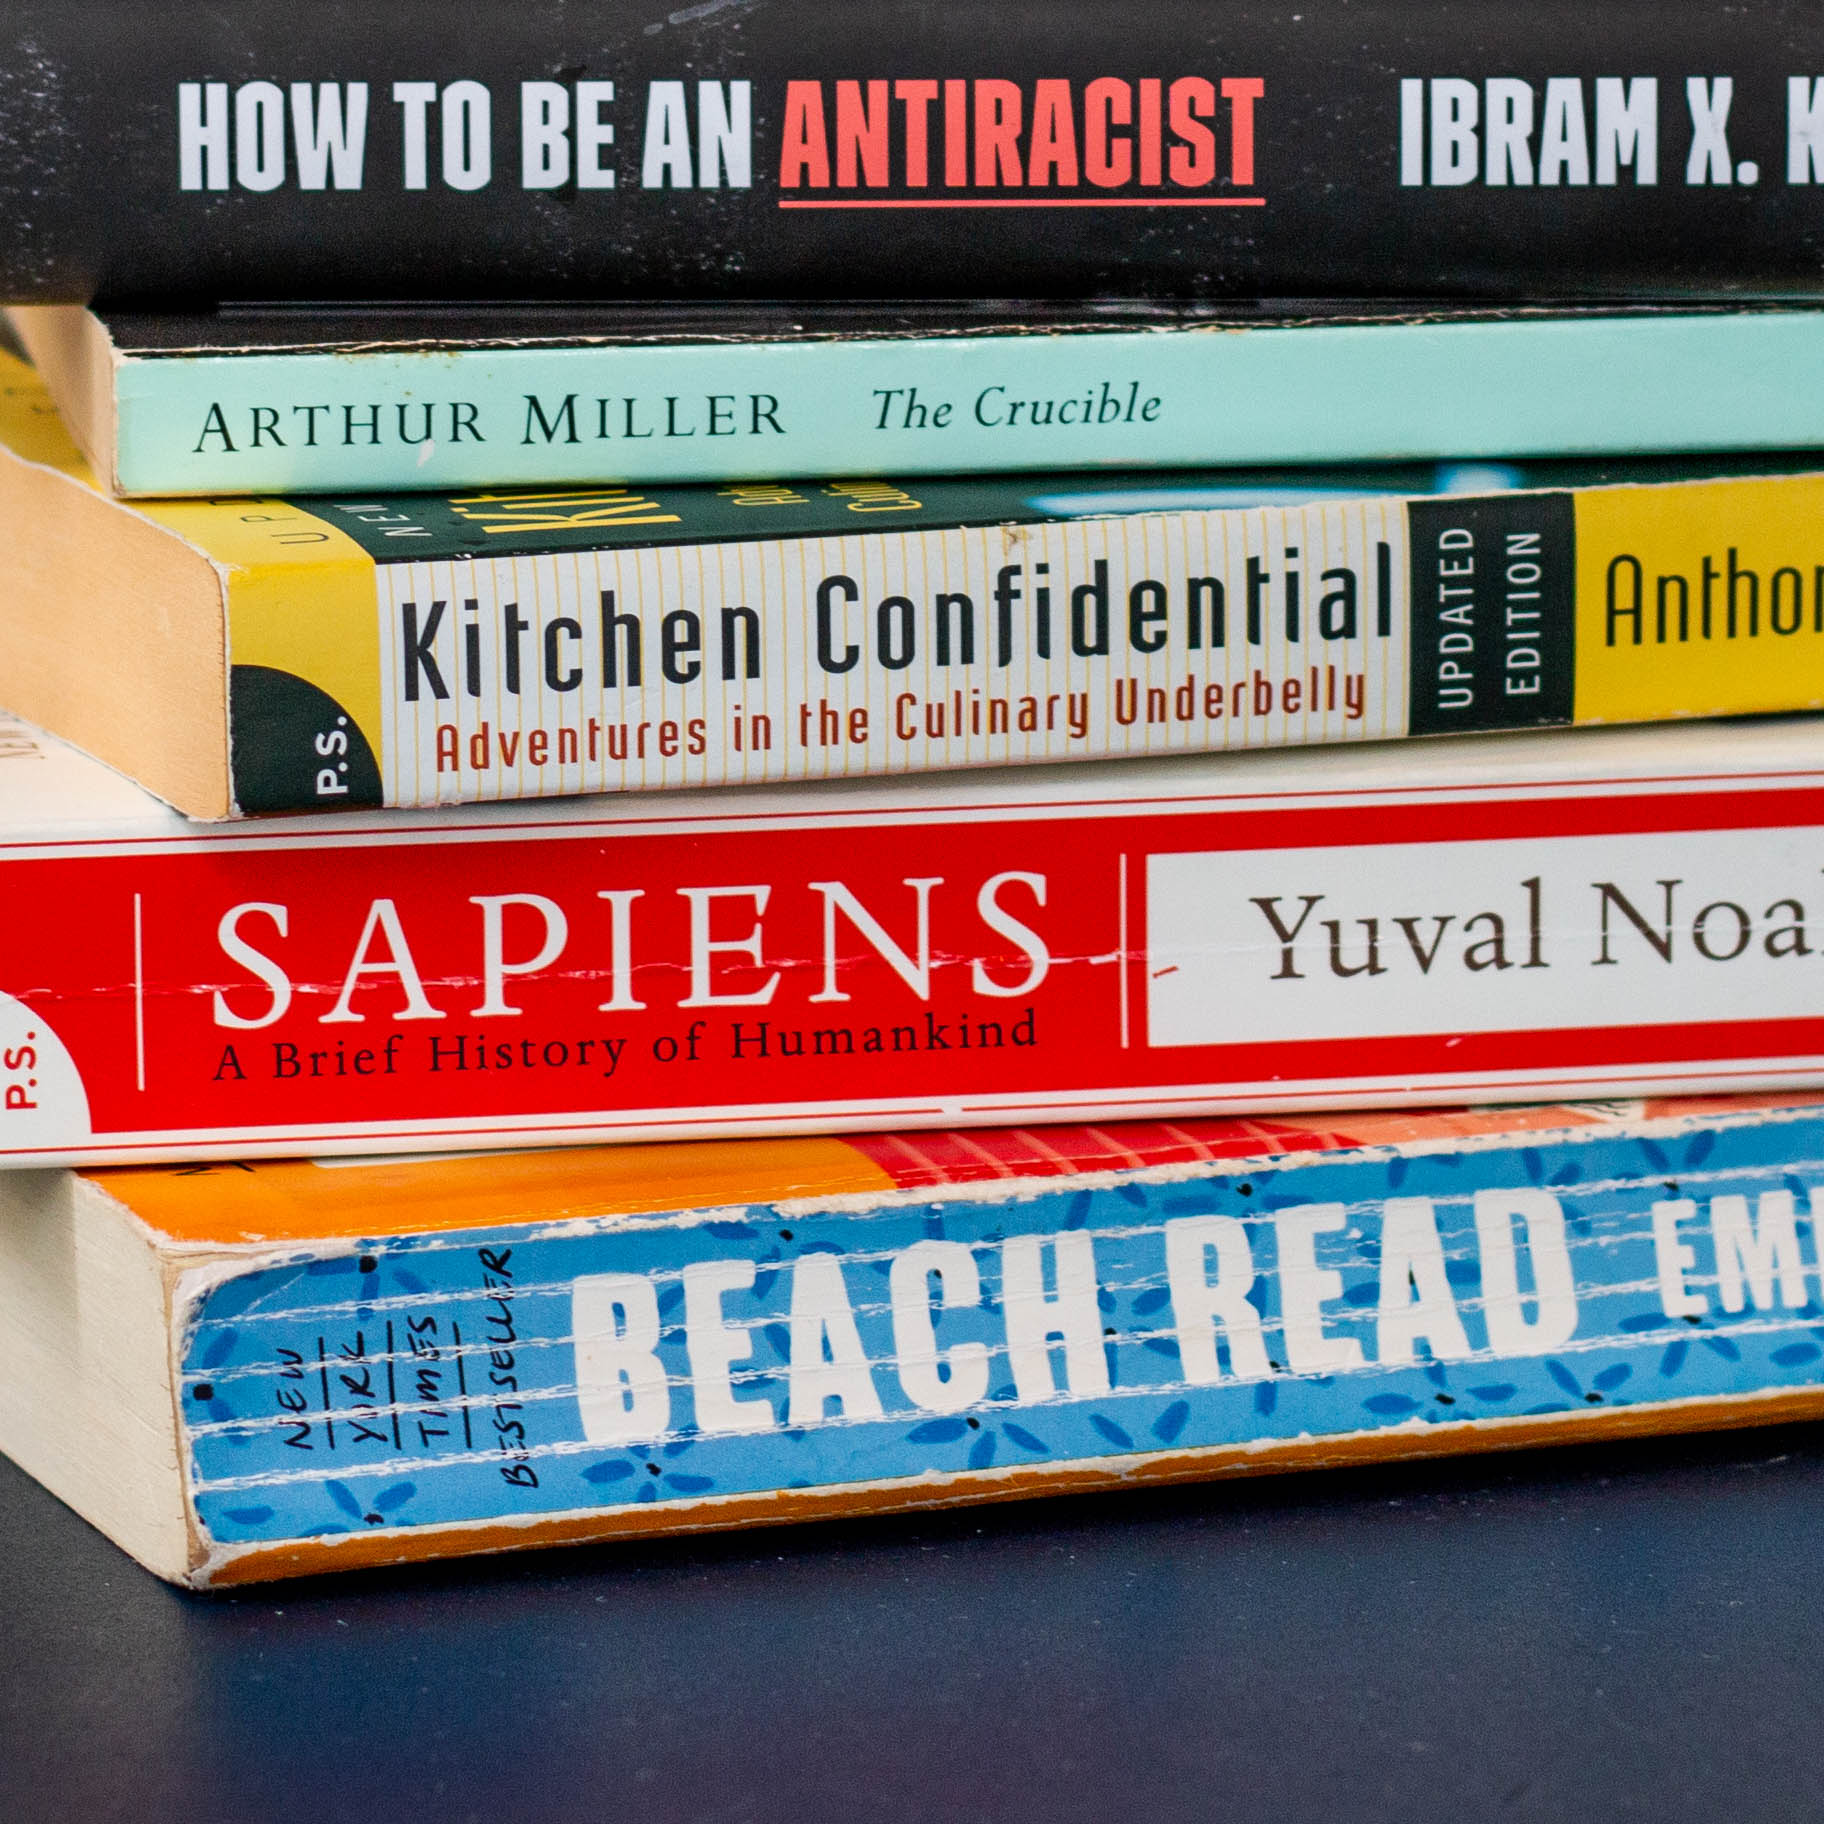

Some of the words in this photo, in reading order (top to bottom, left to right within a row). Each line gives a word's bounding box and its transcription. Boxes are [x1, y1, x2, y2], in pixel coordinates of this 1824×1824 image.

[178, 79, 370, 193] HOW
[391, 78, 492, 192] TO
[520, 79, 616, 191] BE
[641, 78, 753, 190] AN
[778, 75, 1265, 189] ANTIRACIST
[1399, 76, 1658, 187] IBRAM
[1685, 75, 1760, 187] X.
[191, 400, 487, 454] ARTHUR
[519, 392, 788, 447] MILLER
[871, 387, 954, 432] The
[974, 380, 1164, 428] Crucible
[402, 589, 760, 704] Kitchen
[815, 541, 1393, 676] Confidential
[1438, 526, 1474, 709] UPDATED
[1506, 531, 1542, 696] EDITION
[316, 714, 349, 796] P.S.
[435, 717, 707, 774] Adventures
[733, 702, 772, 751] in
[799, 696, 869, 748] the
[895, 688, 1089, 742] Culinary
[1114, 665, 1367, 726] Underbelly
[211, 870, 1050, 1032] SAPIENS
[1249, 877, 1550, 981] Yuval
[4, 1030, 38, 1112] P.S.
[213, 1044, 247, 1084] A
[272, 1036, 404, 1082] Brief
[428, 1030, 625, 1082] History
[652, 1022, 706, 1063] of
[730, 1009, 1039, 1060] Humankind
[477, 1247, 540, 1489] BESTSELLER
[574, 1228, 1112, 1447] BEACH
[1163, 1186, 1579, 1387] READ
[276, 1347, 315, 1451] NEW
[339, 1330, 389, 1444] YORK
[406, 1314, 451, 1448] TIMES
